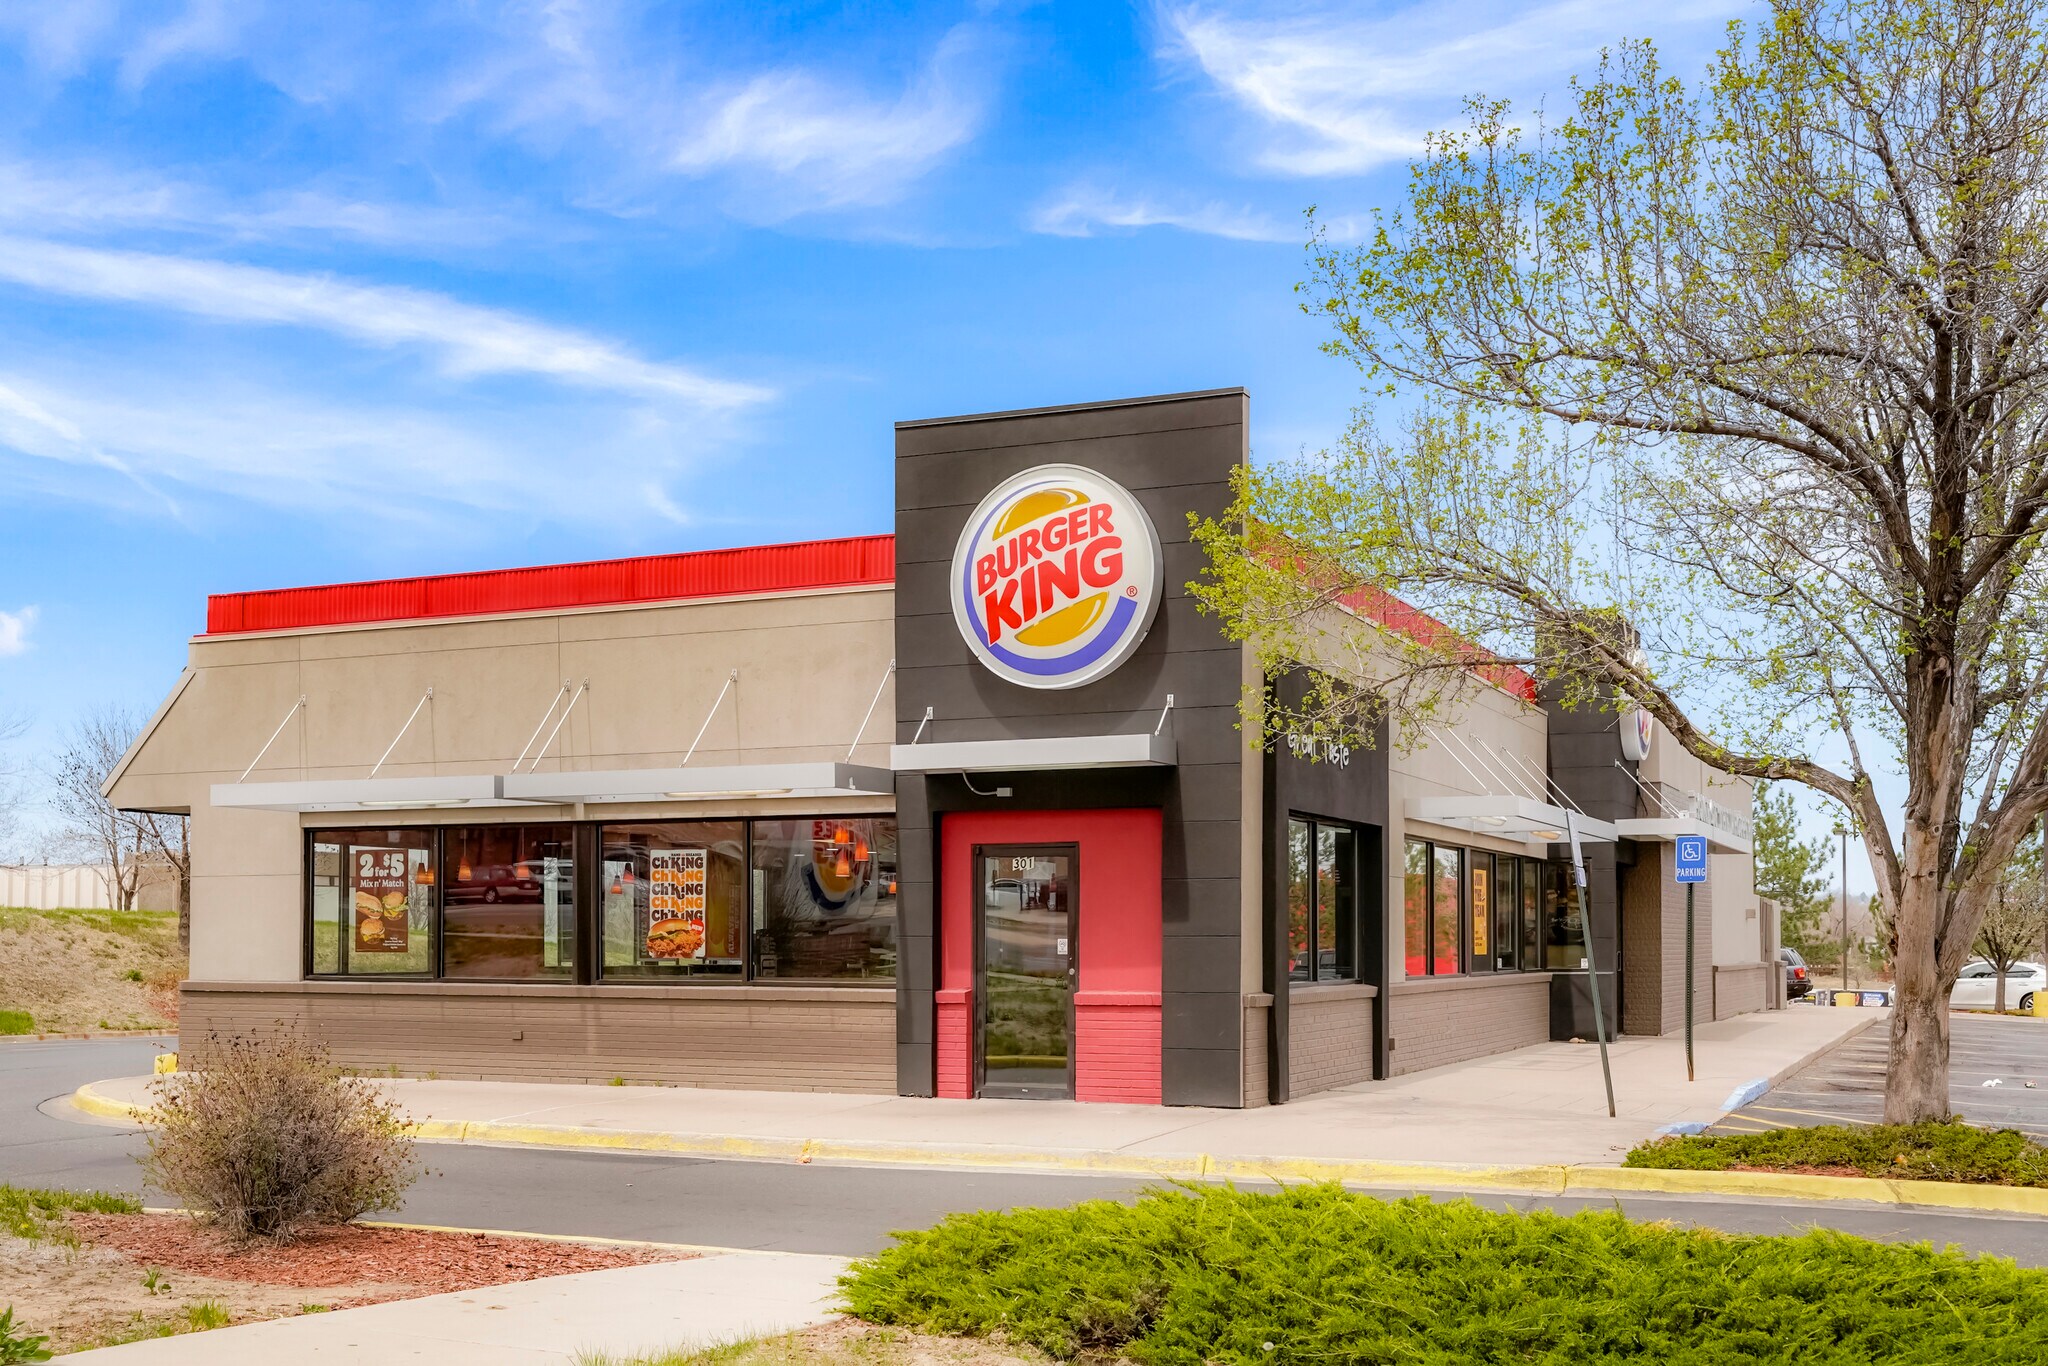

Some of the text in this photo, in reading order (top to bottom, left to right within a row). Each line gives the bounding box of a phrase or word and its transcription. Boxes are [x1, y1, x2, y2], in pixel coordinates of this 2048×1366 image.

[976, 503, 1115, 597] BURGER
[984, 535, 1123, 645] KING
[360, 853, 405, 877] 2 for $5
[1013, 858, 1032, 869] 301
[1677, 867, 1706, 877] PARKING
[360, 879, 373, 888] Mix
[382, 879, 405, 888] Match
